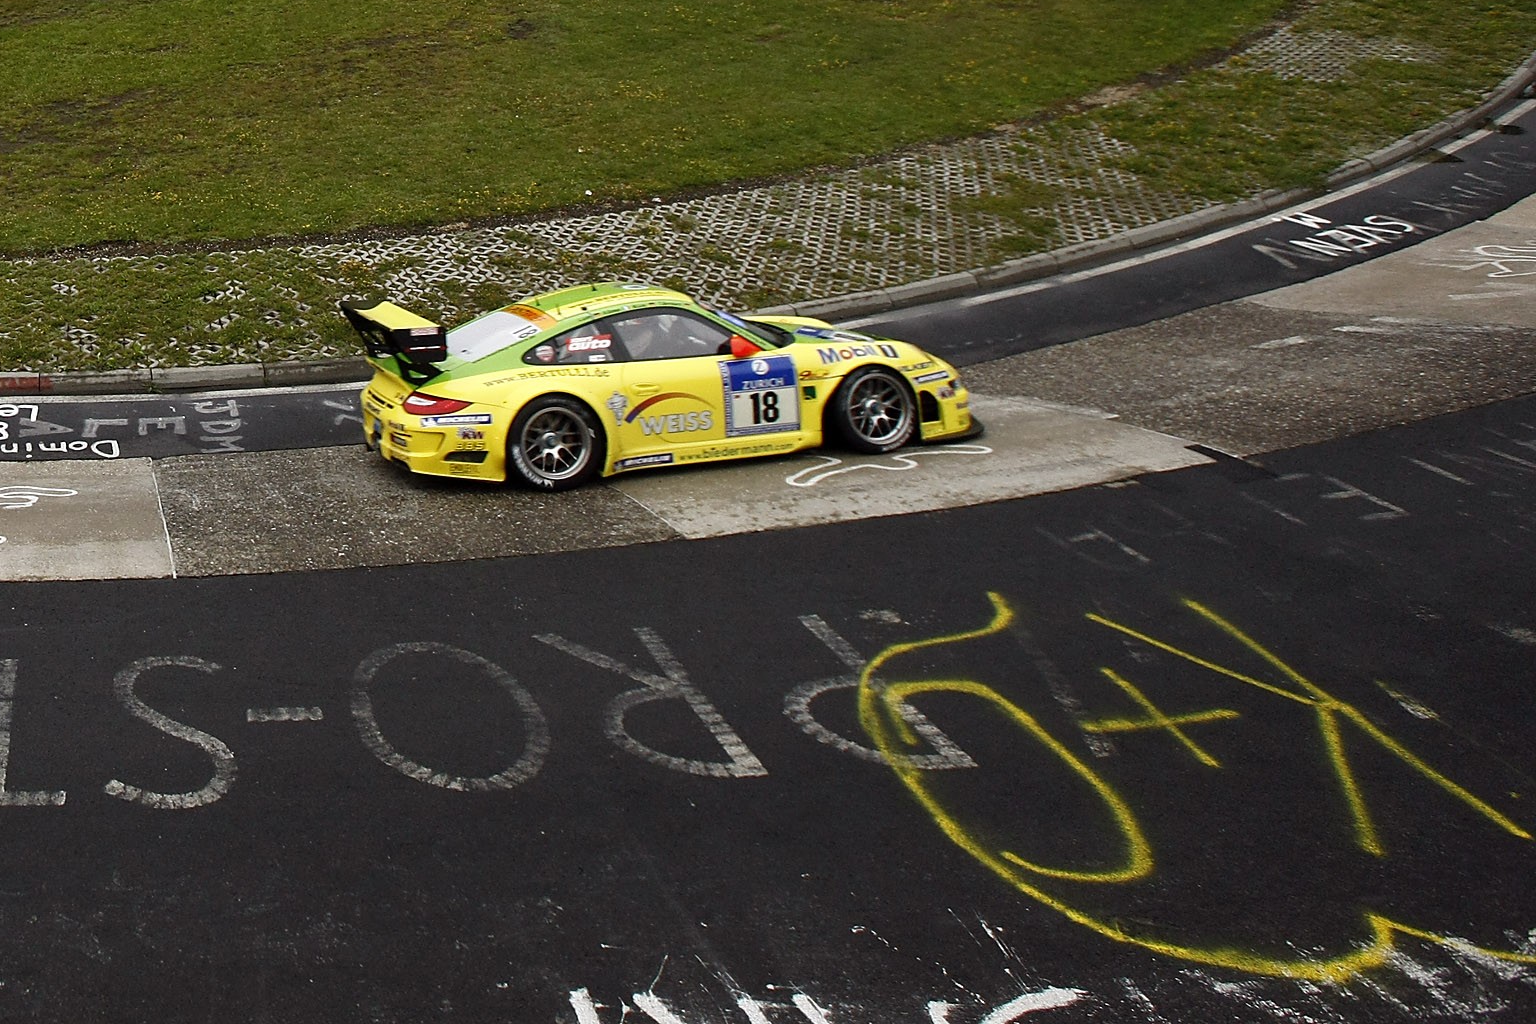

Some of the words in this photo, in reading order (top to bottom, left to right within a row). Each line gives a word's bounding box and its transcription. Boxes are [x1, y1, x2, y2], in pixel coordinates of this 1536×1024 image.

[1288, 215, 1415, 258] SVEN
[568, 338, 612, 351] auto
[817, 345, 879, 365] Mobil
[483, 366, 611, 388] www.BERTULLI.de
[741, 377, 785, 390] ZURICH
[749, 391, 780, 425] 18
[639, 410, 714, 436] WEISS
